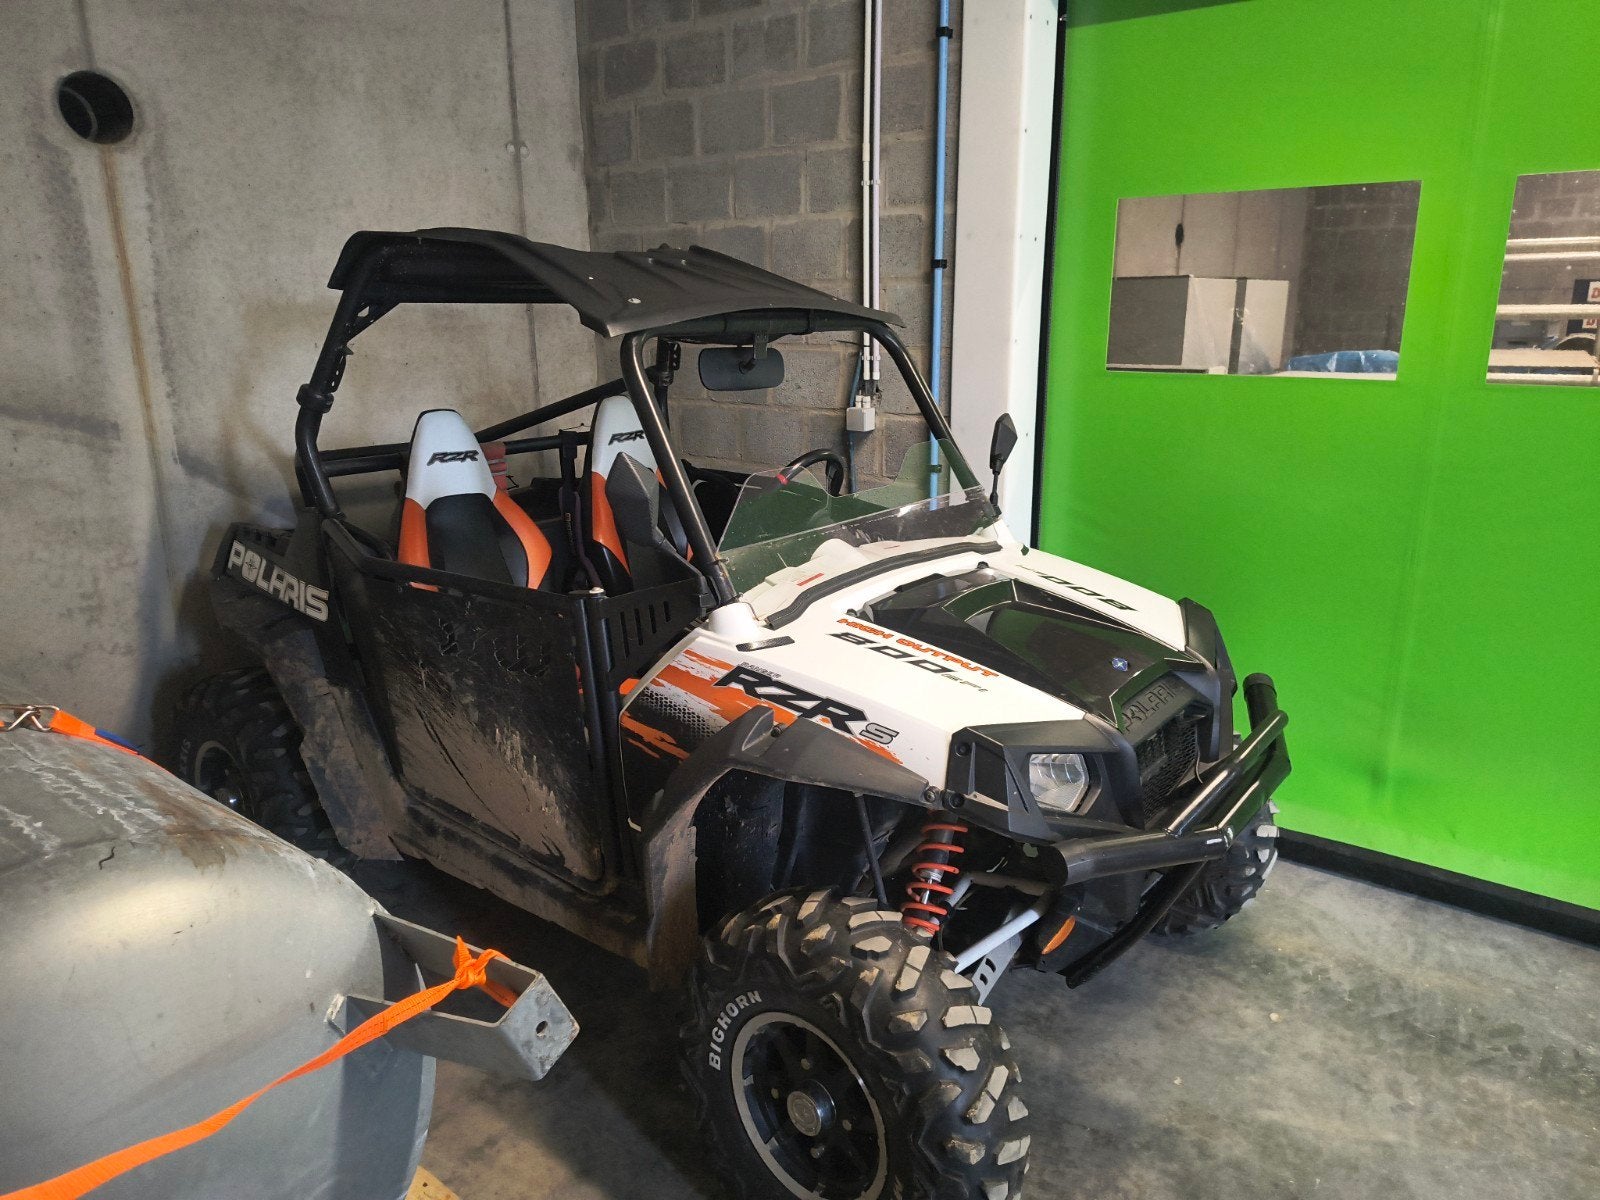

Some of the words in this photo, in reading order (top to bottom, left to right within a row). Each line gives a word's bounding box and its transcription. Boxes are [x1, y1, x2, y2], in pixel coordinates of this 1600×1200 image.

[427, 450, 480, 467] RZR
[608, 429, 645, 446] RZR
[227, 540, 330, 622] POLARIS
[826, 632, 957, 674] 800
[836, 618, 895, 639] HIGH
[895, 638, 1000, 677] OUTPUT
[713, 664, 869, 736] RZR
[859, 722, 900, 745] S
[708, 990, 762, 1071] BIGHORN
